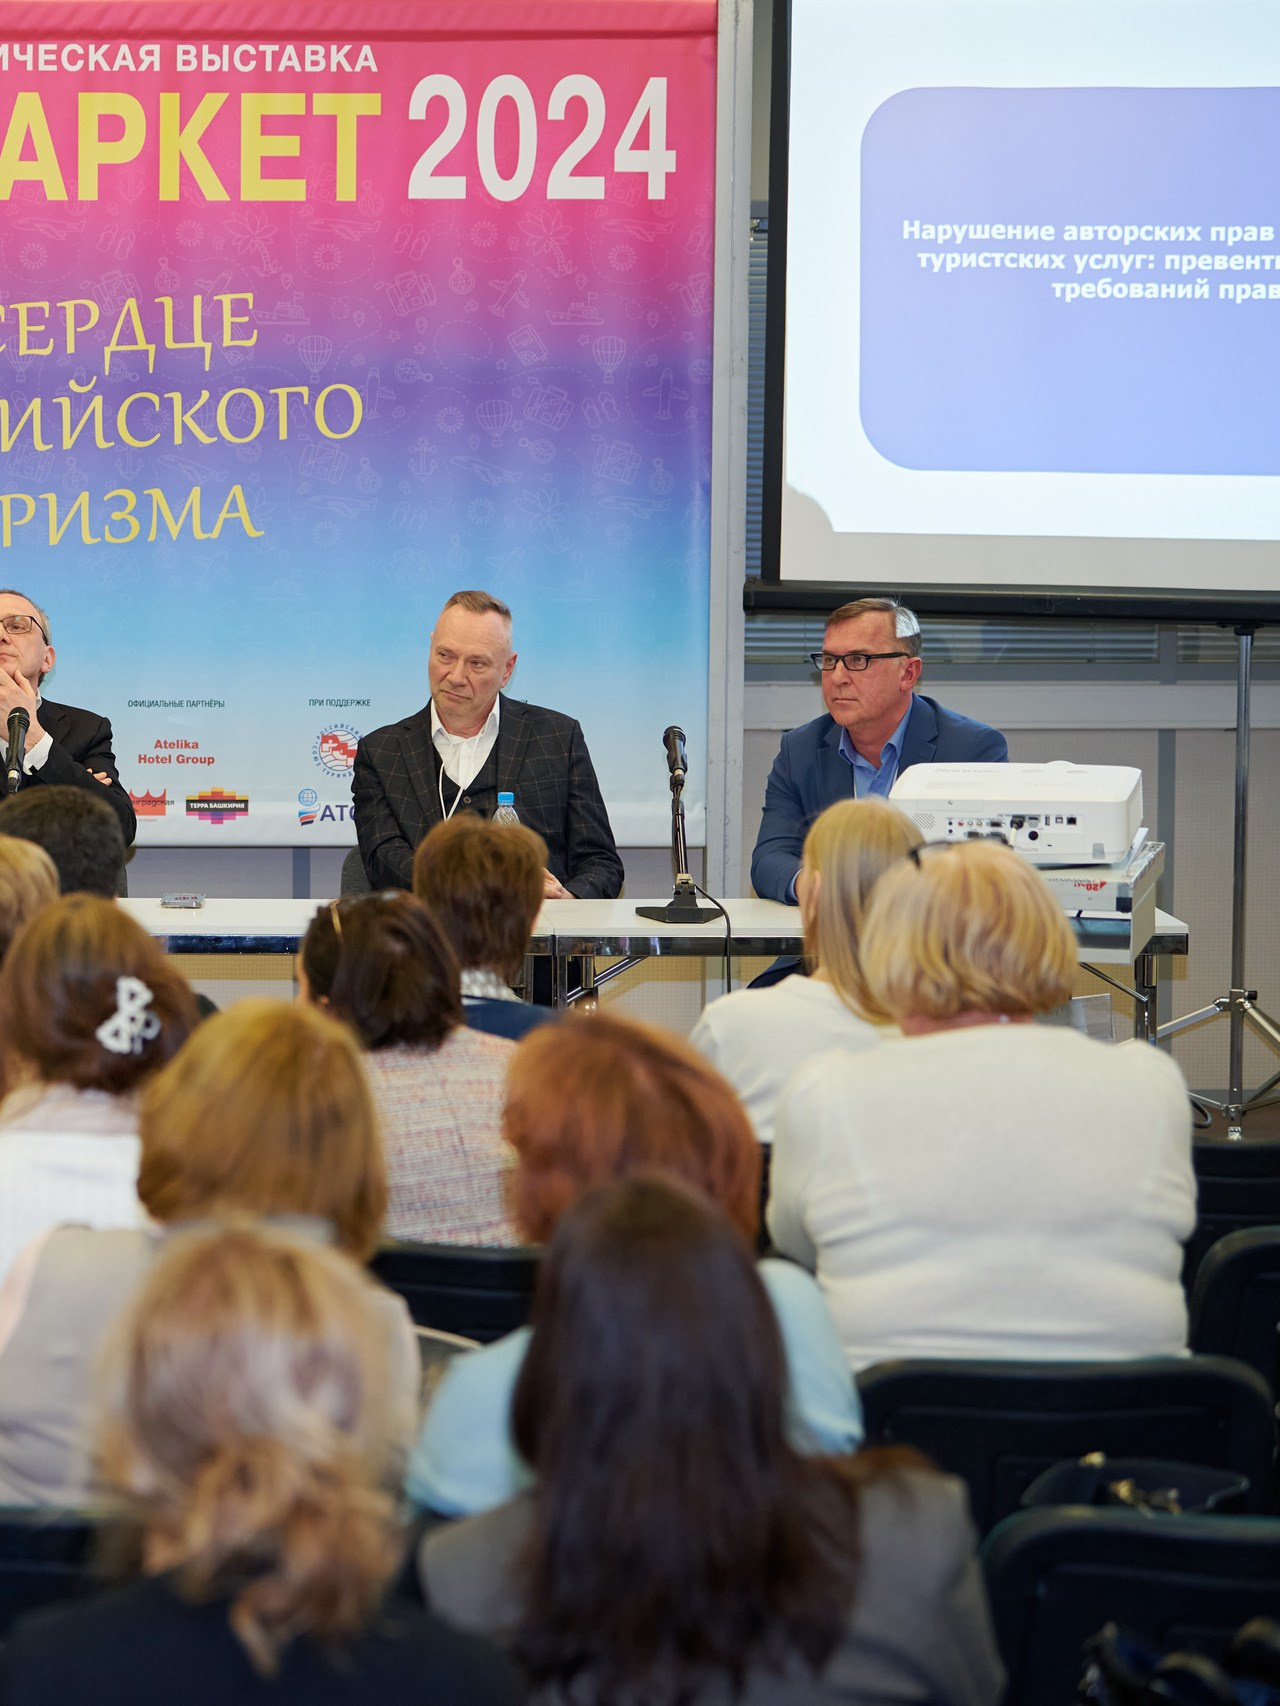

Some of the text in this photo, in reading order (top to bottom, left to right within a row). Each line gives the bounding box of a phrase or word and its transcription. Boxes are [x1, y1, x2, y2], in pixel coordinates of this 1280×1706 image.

[176, 44, 378, 73] ВЫСТАВКА
[407, 73, 677, 202] 2024
[902, 220, 1275, 246] Нарушение авторских прав
[917, 251, 1066, 273] туристских
[1073, 254, 1155, 275] услуг:
[1051, 278, 1280, 304] требований прав
[127, 698, 225, 709] ОФИЦИАЛЬНЫЕ ПАРТНЁРЫ
[308, 698, 372, 708] ПРИ ПОДДЕРЖКЕ
[154, 739, 199, 750] Atelika
[137, 754, 215, 766] Hotel Group
[321, 768, 353, 779] ТУРИНД
